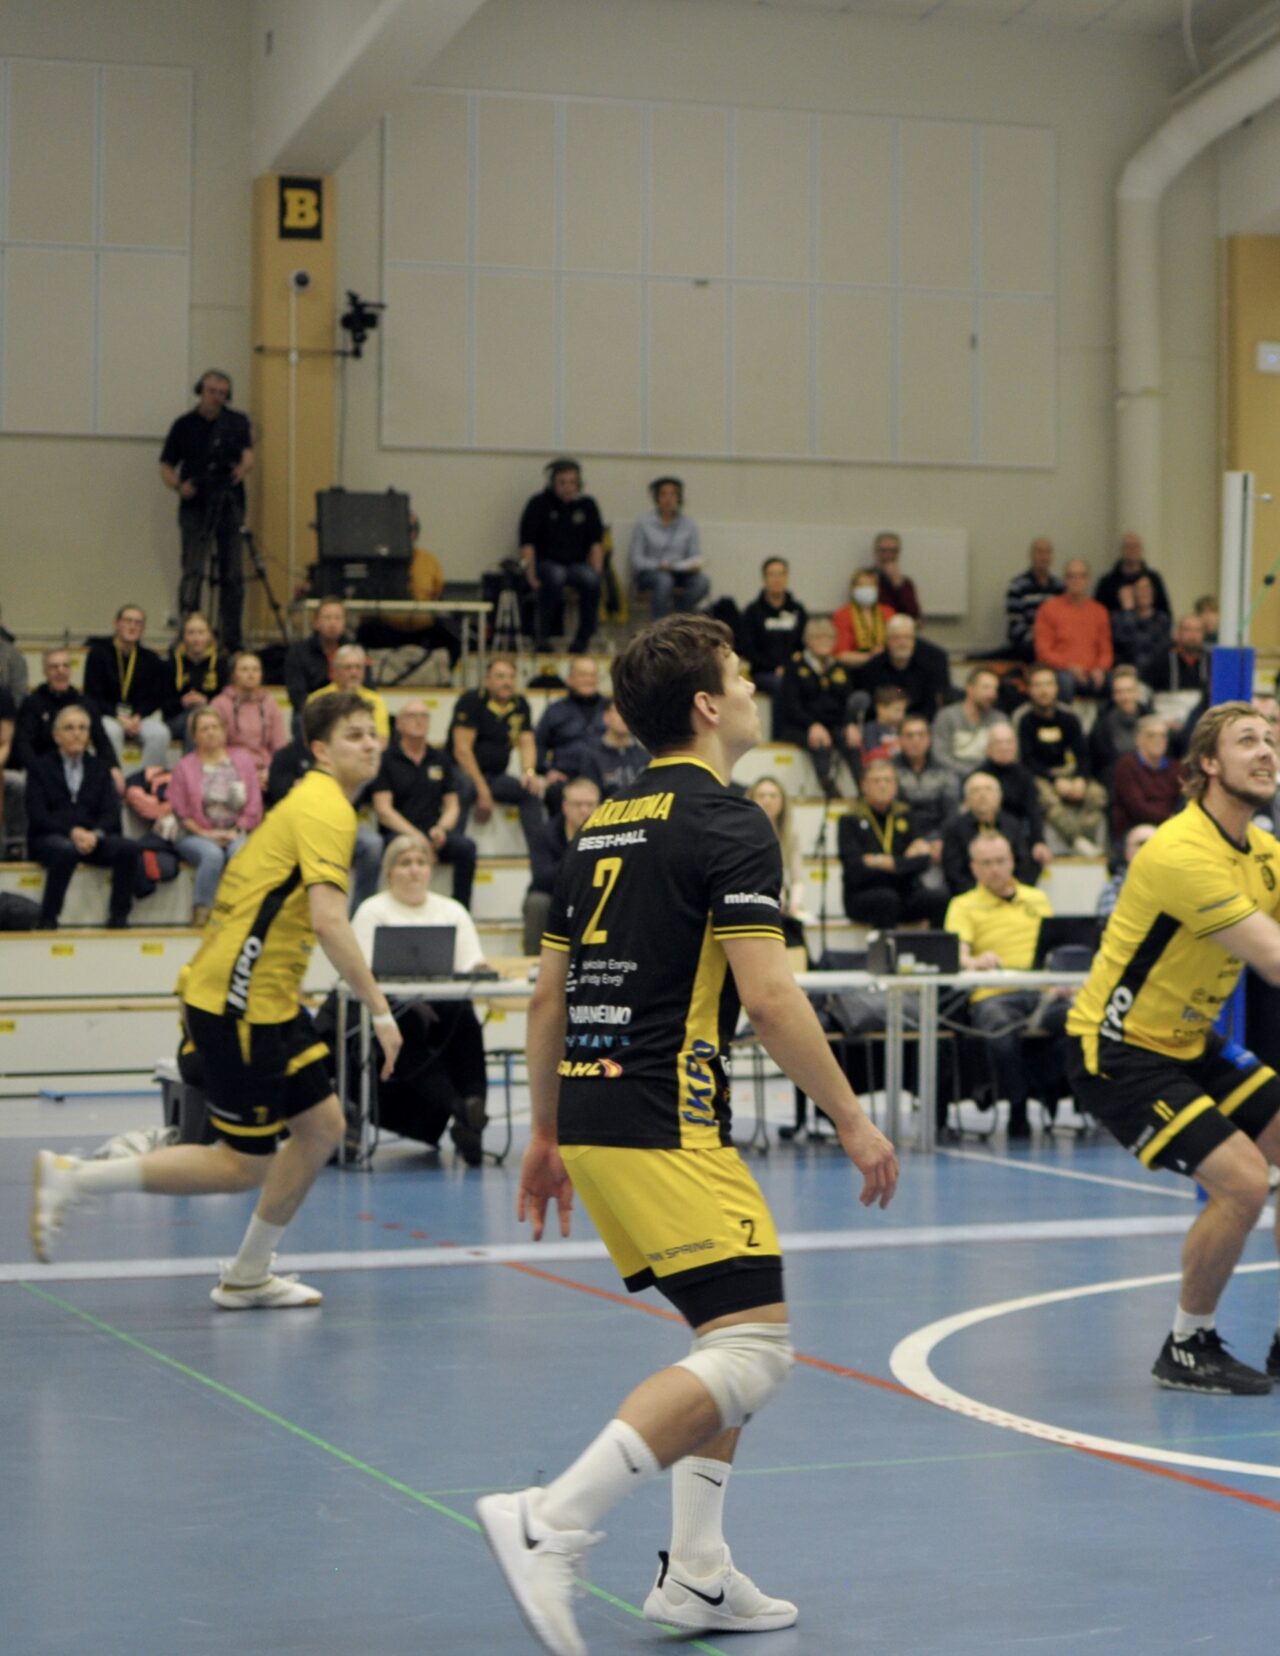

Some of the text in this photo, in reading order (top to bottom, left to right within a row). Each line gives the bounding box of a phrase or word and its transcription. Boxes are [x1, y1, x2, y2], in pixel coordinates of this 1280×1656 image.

[284, 187, 319, 229] B
[577, 829, 648, 852] BEST-HALL
[581, 856, 622, 945] 2
[740, 1218, 761, 1248] 2
